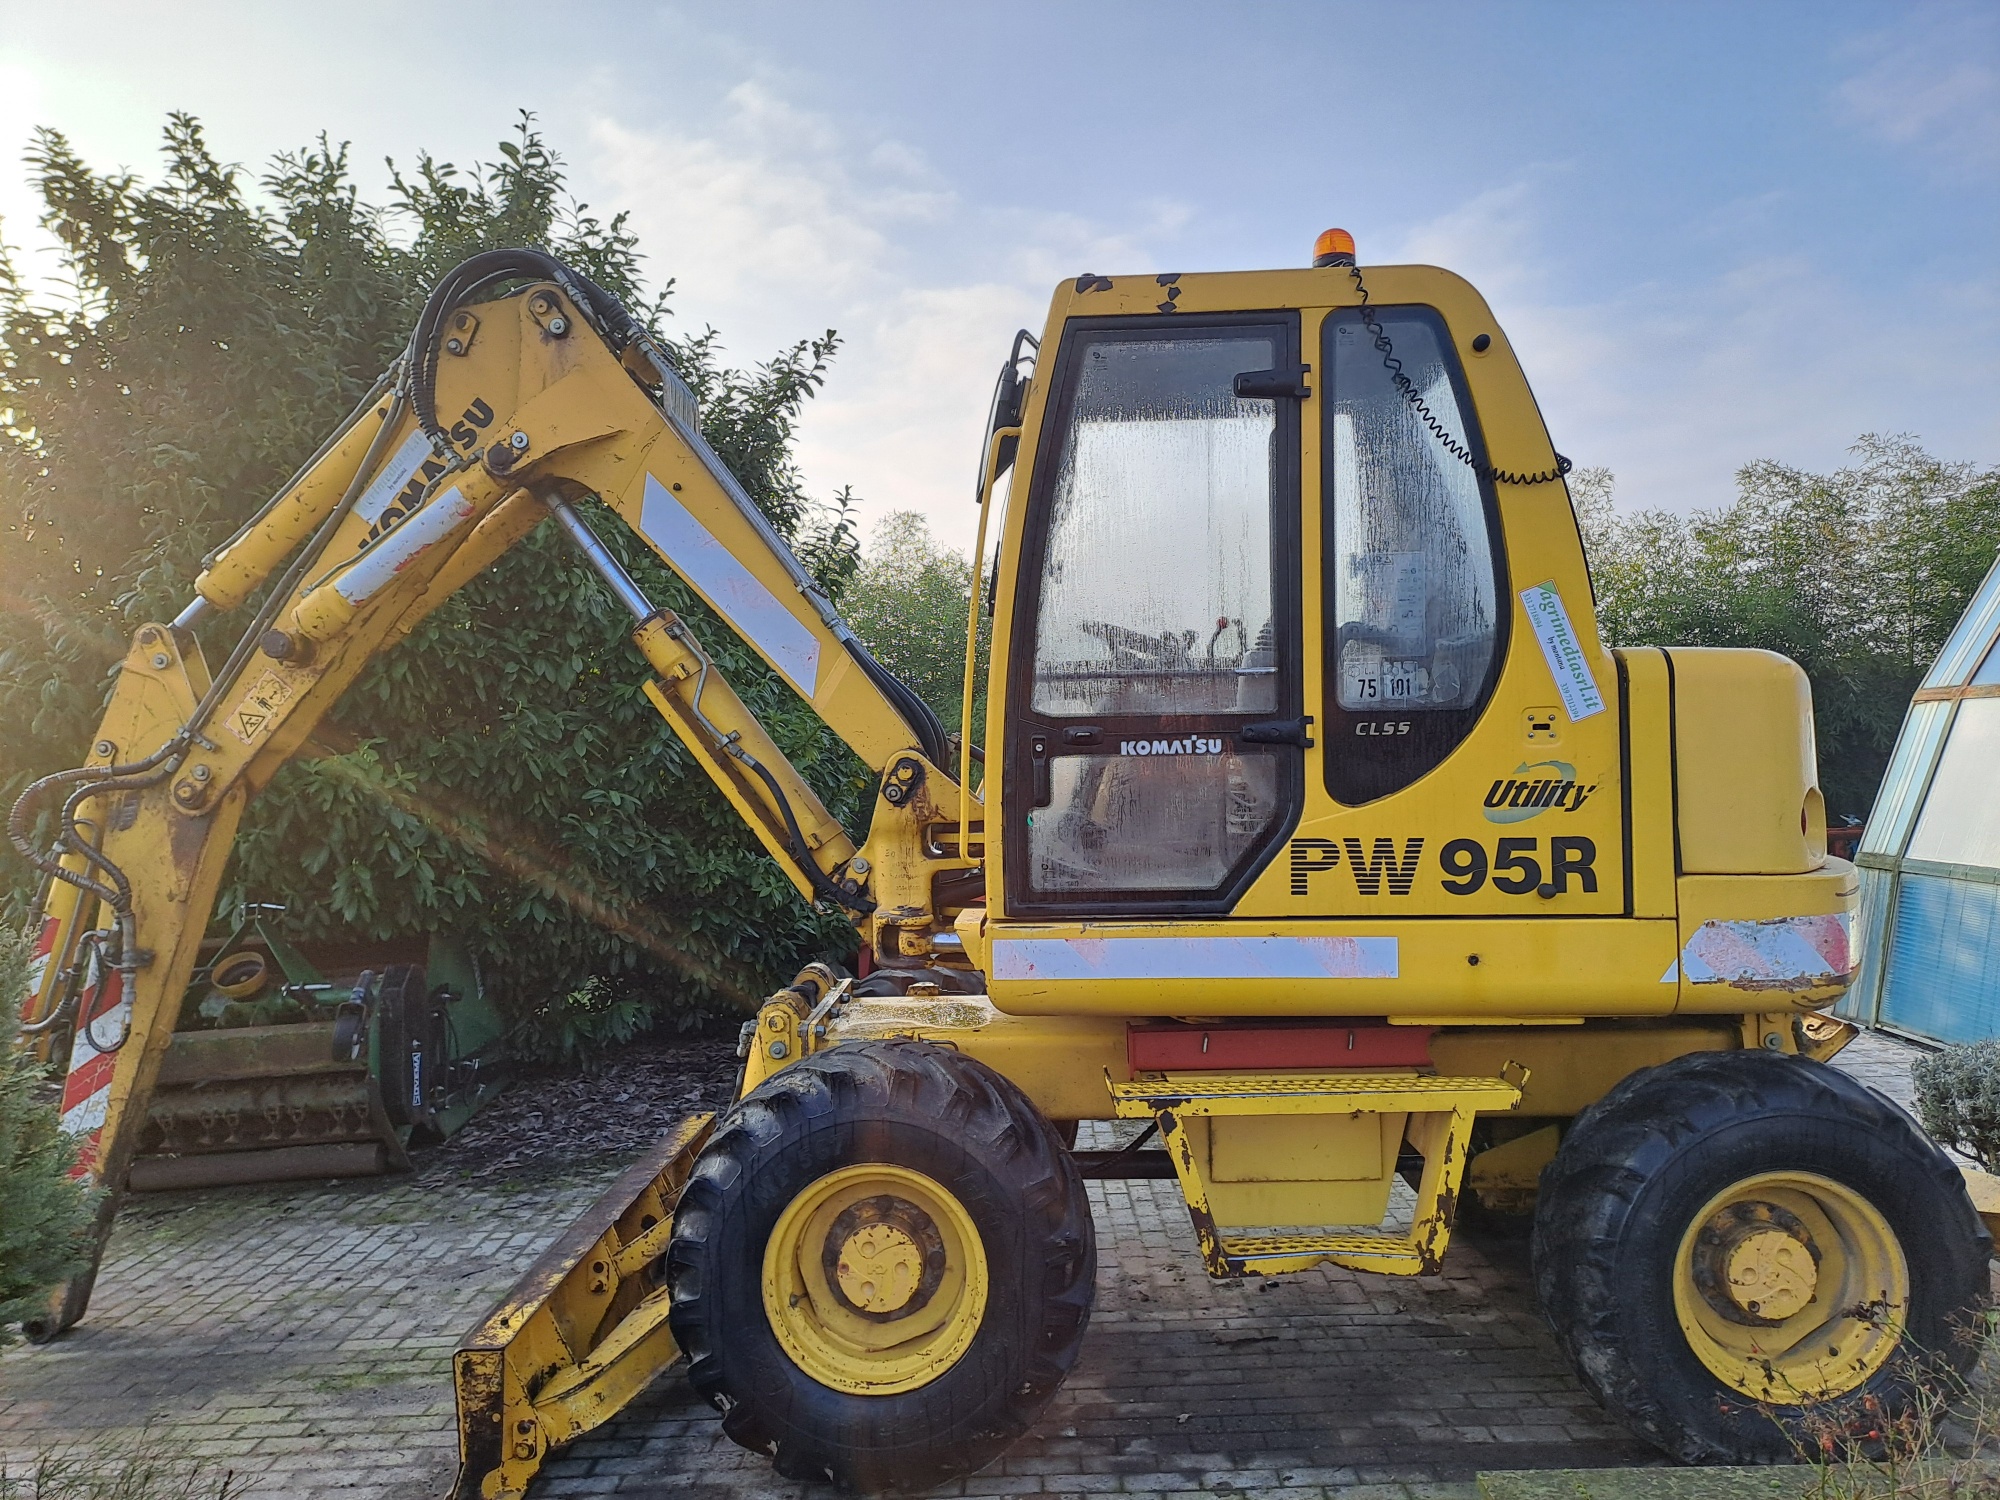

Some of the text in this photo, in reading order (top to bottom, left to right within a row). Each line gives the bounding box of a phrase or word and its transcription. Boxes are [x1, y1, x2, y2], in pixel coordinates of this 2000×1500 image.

[1539, 590, 1600, 709] agrimediasrl.it
[1358, 679, 1377, 698] 75
[1391, 679, 1411, 696] 101
[1355, 721, 1411, 736] CLSS
[1120, 735, 1222, 756] KOMATSU
[1483, 780, 1597, 812] Utility
[1290, 837, 1425, 895] PW
